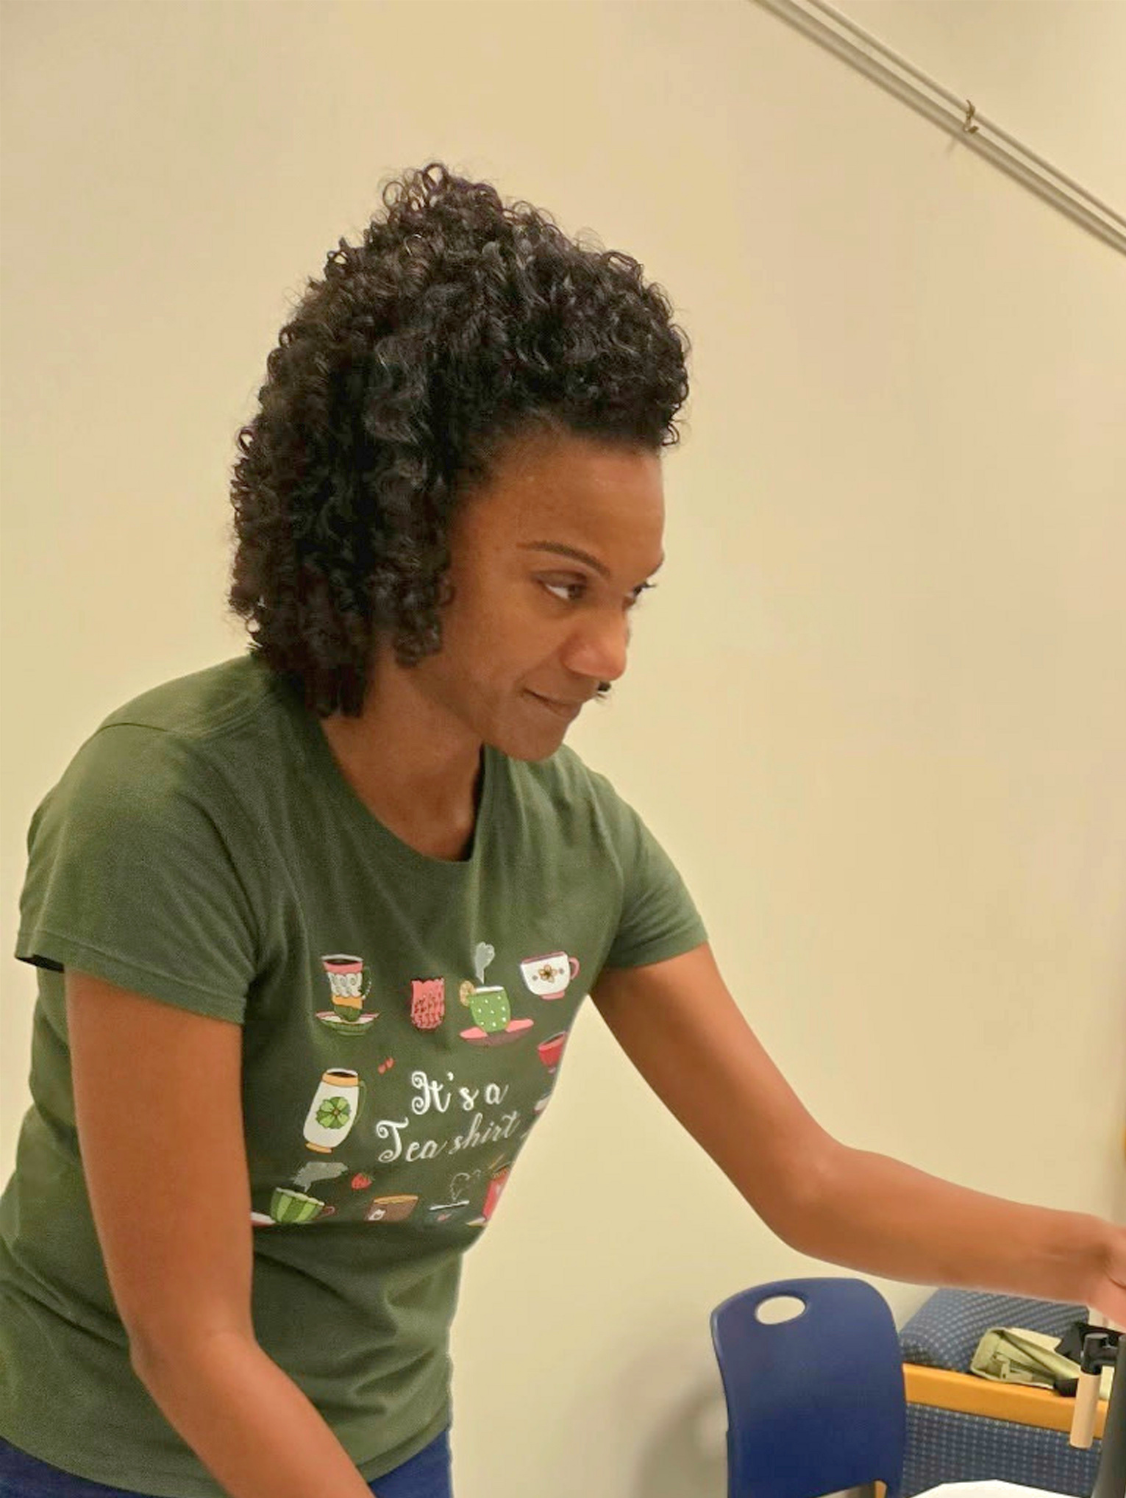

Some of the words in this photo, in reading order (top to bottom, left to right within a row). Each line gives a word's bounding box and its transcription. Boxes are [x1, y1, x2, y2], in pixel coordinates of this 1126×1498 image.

[411, 1070, 480, 1115] It's
[485, 1083, 510, 1105] a
[376, 1116, 448, 1163] Tea
[449, 1110, 521, 1155] shirt
